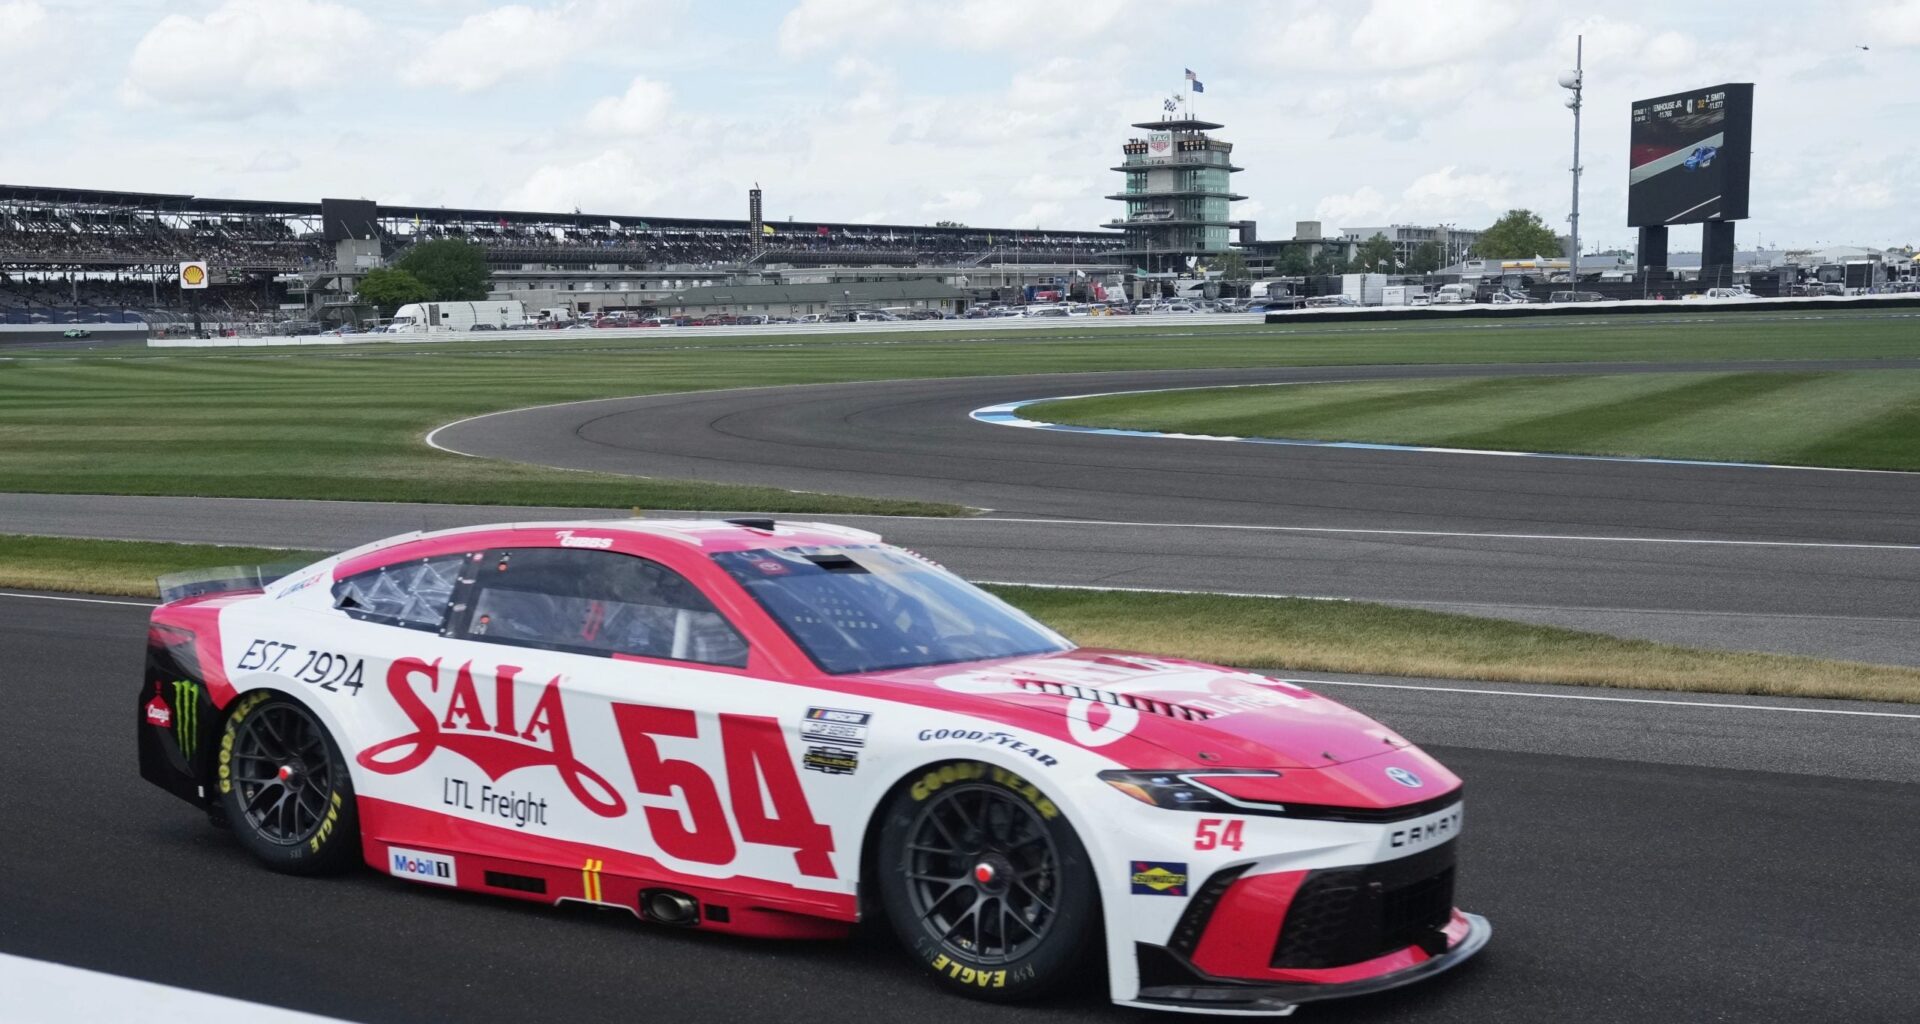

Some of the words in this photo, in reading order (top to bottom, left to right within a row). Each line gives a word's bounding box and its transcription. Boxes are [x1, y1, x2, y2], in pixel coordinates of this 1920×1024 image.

[237, 639, 297, 672] EST.
[294, 650, 364, 696] 1924
[443, 776, 474, 810] LTL
[481, 785, 548, 828] Freight
[610, 701, 838, 880] 54
[310, 791, 342, 853] EAGLE
[1193, 818, 1245, 851] 54
[394, 854, 434, 876] Mobil
[931, 953, 1007, 988] EAGLE
